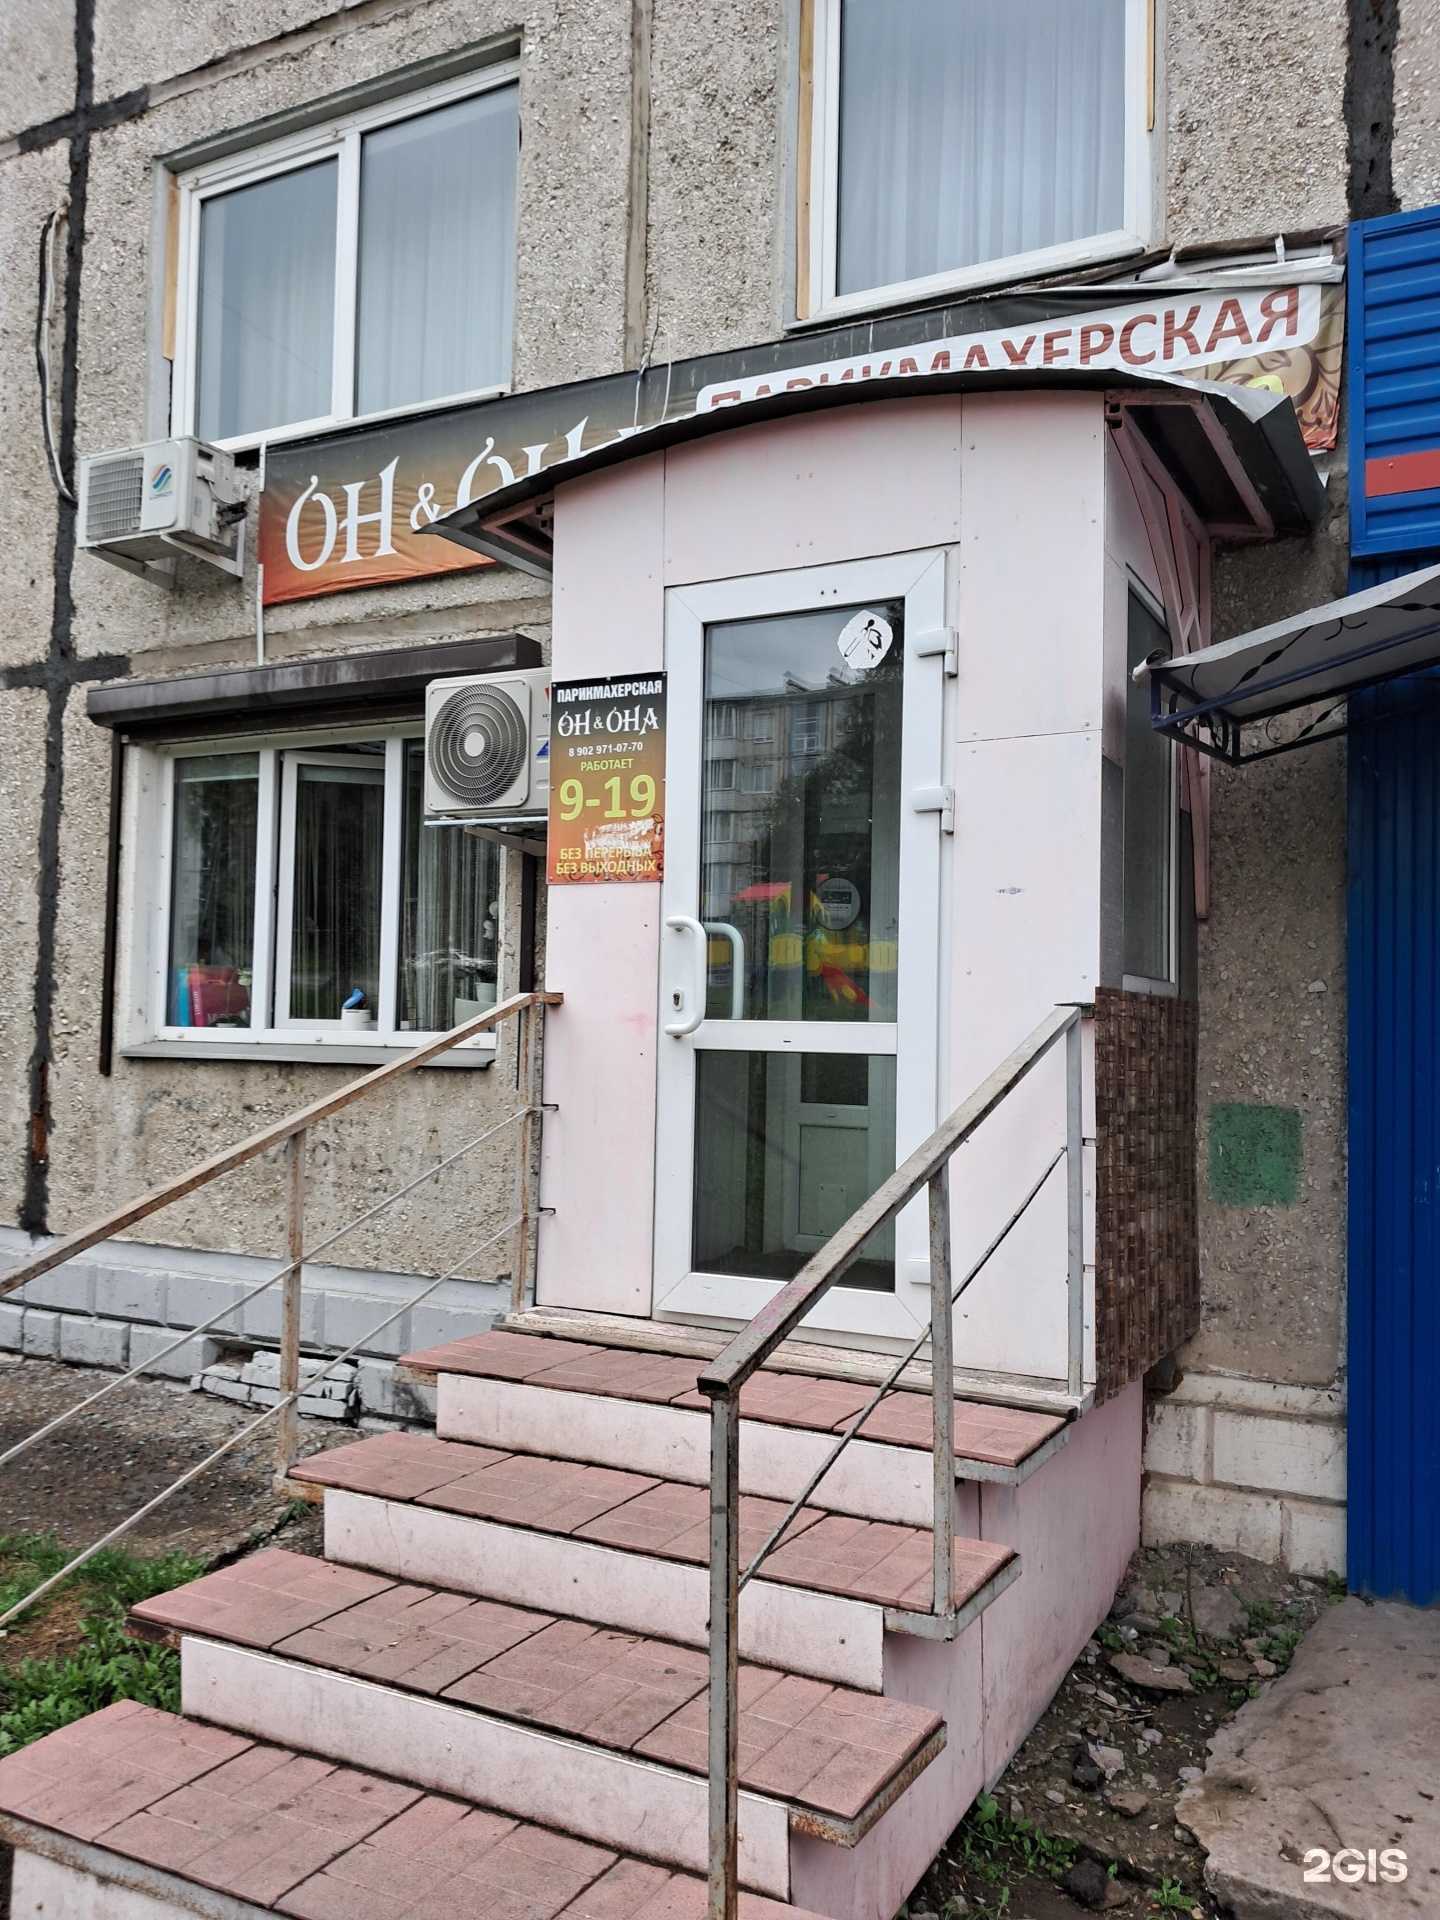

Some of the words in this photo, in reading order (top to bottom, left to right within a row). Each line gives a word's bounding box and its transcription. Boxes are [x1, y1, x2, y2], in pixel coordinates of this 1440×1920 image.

[711, 287, 1299, 407] АХЕРСКАЯ
[557, 680, 663, 703] ПАРИКМАХЕРСКАЯ
[593, 715, 604, 730] &
[568, 747, 575, 757] 8
[577, 745, 594, 757] 902
[596, 741, 644, 754] 971-07-70
[580, 758, 634, 771] РАБОТАЕТ
[559, 774, 656, 821] 9-19
[560, 848, 581, 860] БЕЗ
[556, 862, 577, 874] БЕЗ
[580, 859, 656, 874] ВЫХОДНЫХ
